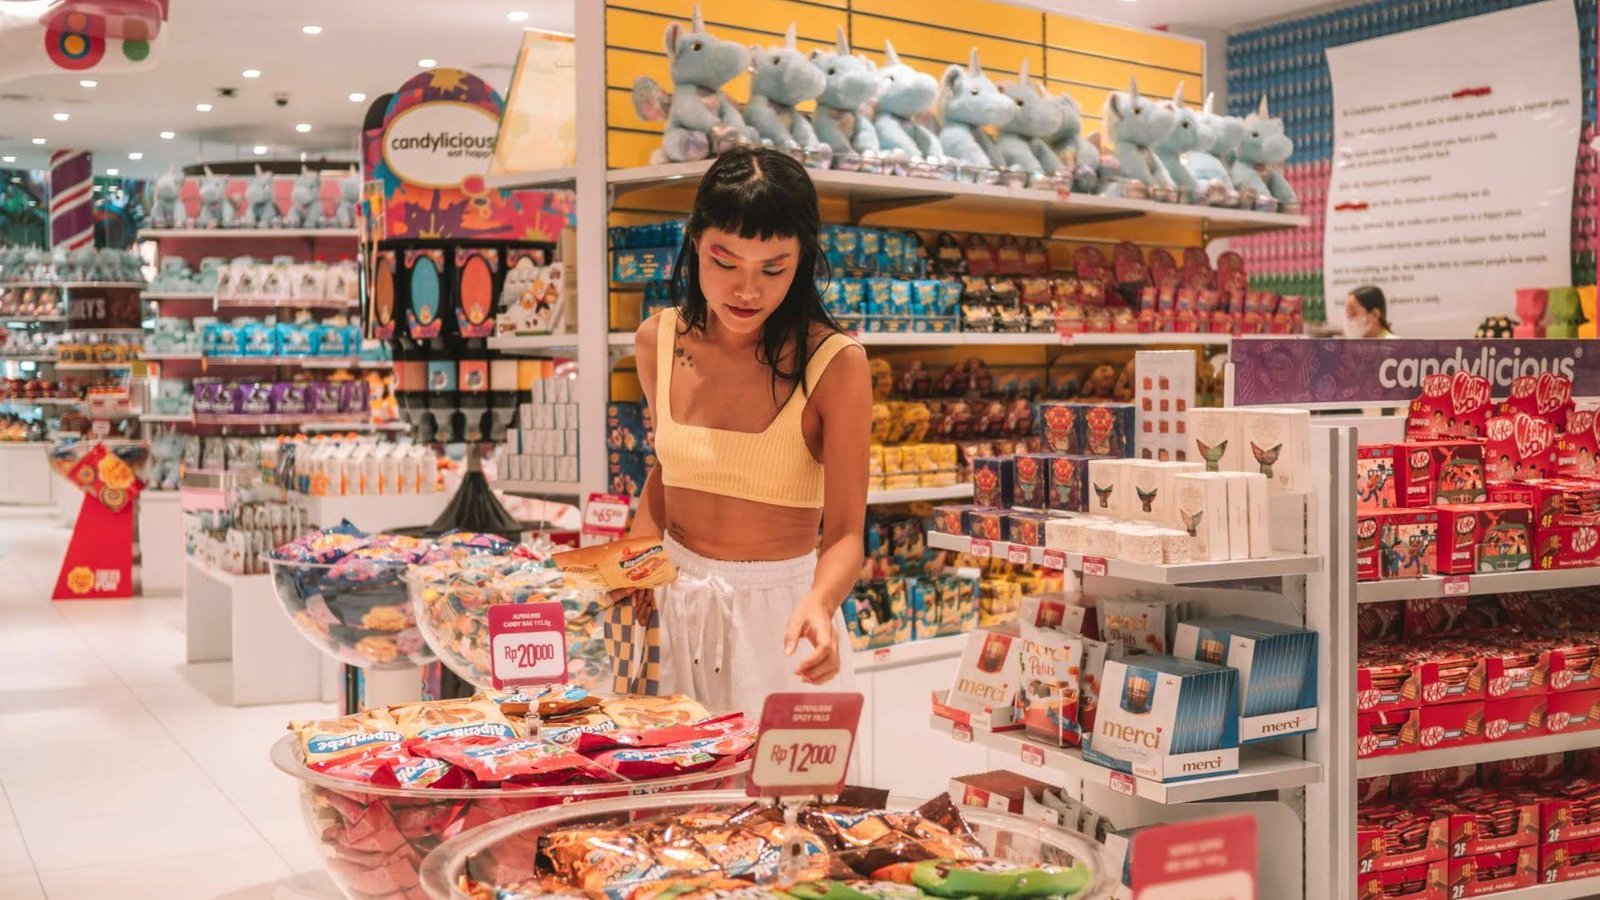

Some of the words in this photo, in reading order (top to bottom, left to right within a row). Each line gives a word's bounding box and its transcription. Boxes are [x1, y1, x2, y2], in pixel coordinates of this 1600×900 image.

[392, 132, 494, 152] candylicious
[1541, 514, 1553, 528] 4F
[1541, 555, 1553, 569] 4F
[503, 620, 521, 628] CANDY
[959, 678, 1009, 702] merci
[1262, 716, 1300, 733] merci
[1102, 719, 1162, 750] merci
[1183, 756, 1223, 772] merci
[1548, 829, 1560, 842] 2F
[1453, 843, 1467, 857] 2F
[1360, 859, 1374, 873] 2F
[1546, 869, 1558, 883] 2F
[1452, 885, 1465, 899] 2F
